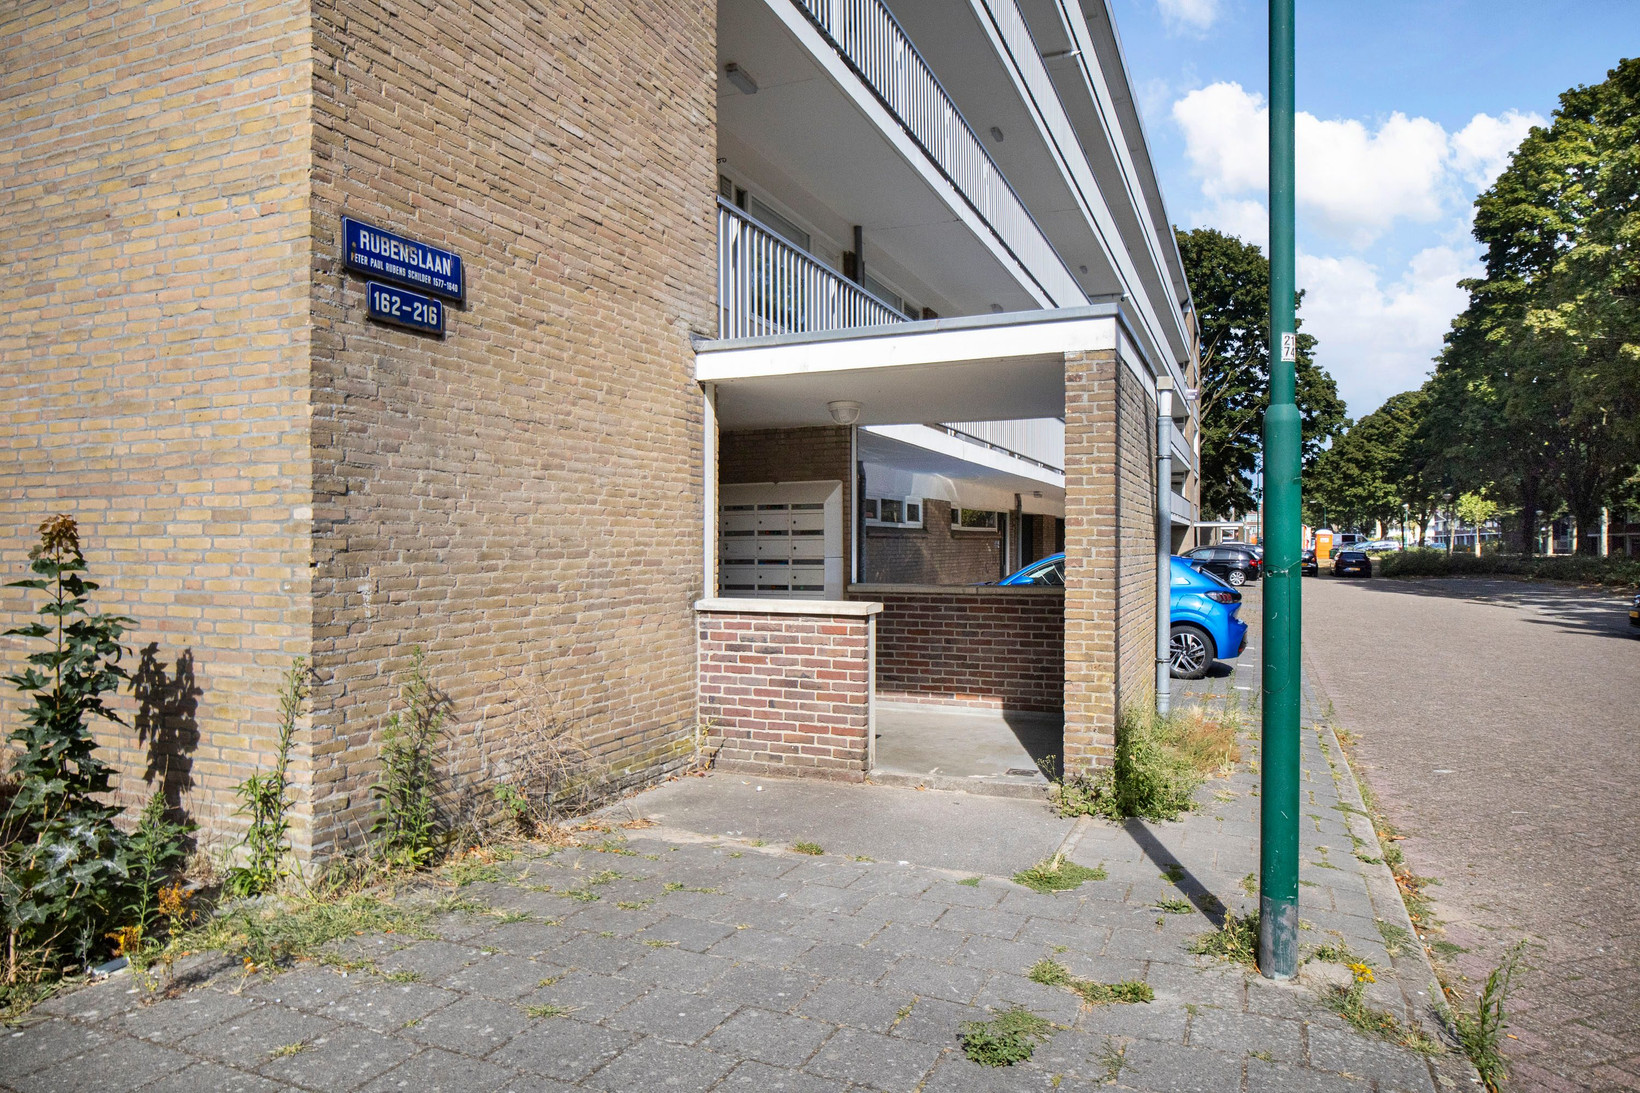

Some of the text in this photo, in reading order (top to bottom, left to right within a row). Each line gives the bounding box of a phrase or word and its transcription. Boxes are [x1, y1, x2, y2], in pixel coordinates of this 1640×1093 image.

[359, 229, 451, 277] RUBENSLAAN
[370, 257, 384, 271] PAUL
[385, 262, 406, 277] RUBENS
[407, 268, 431, 285] SCHILDER
[433, 277, 458, 293] 1577-1640
[373, 291, 437, 325] 162-216
[1284, 335, 1294, 346] 21
[1284, 347, 1294, 357] 74
